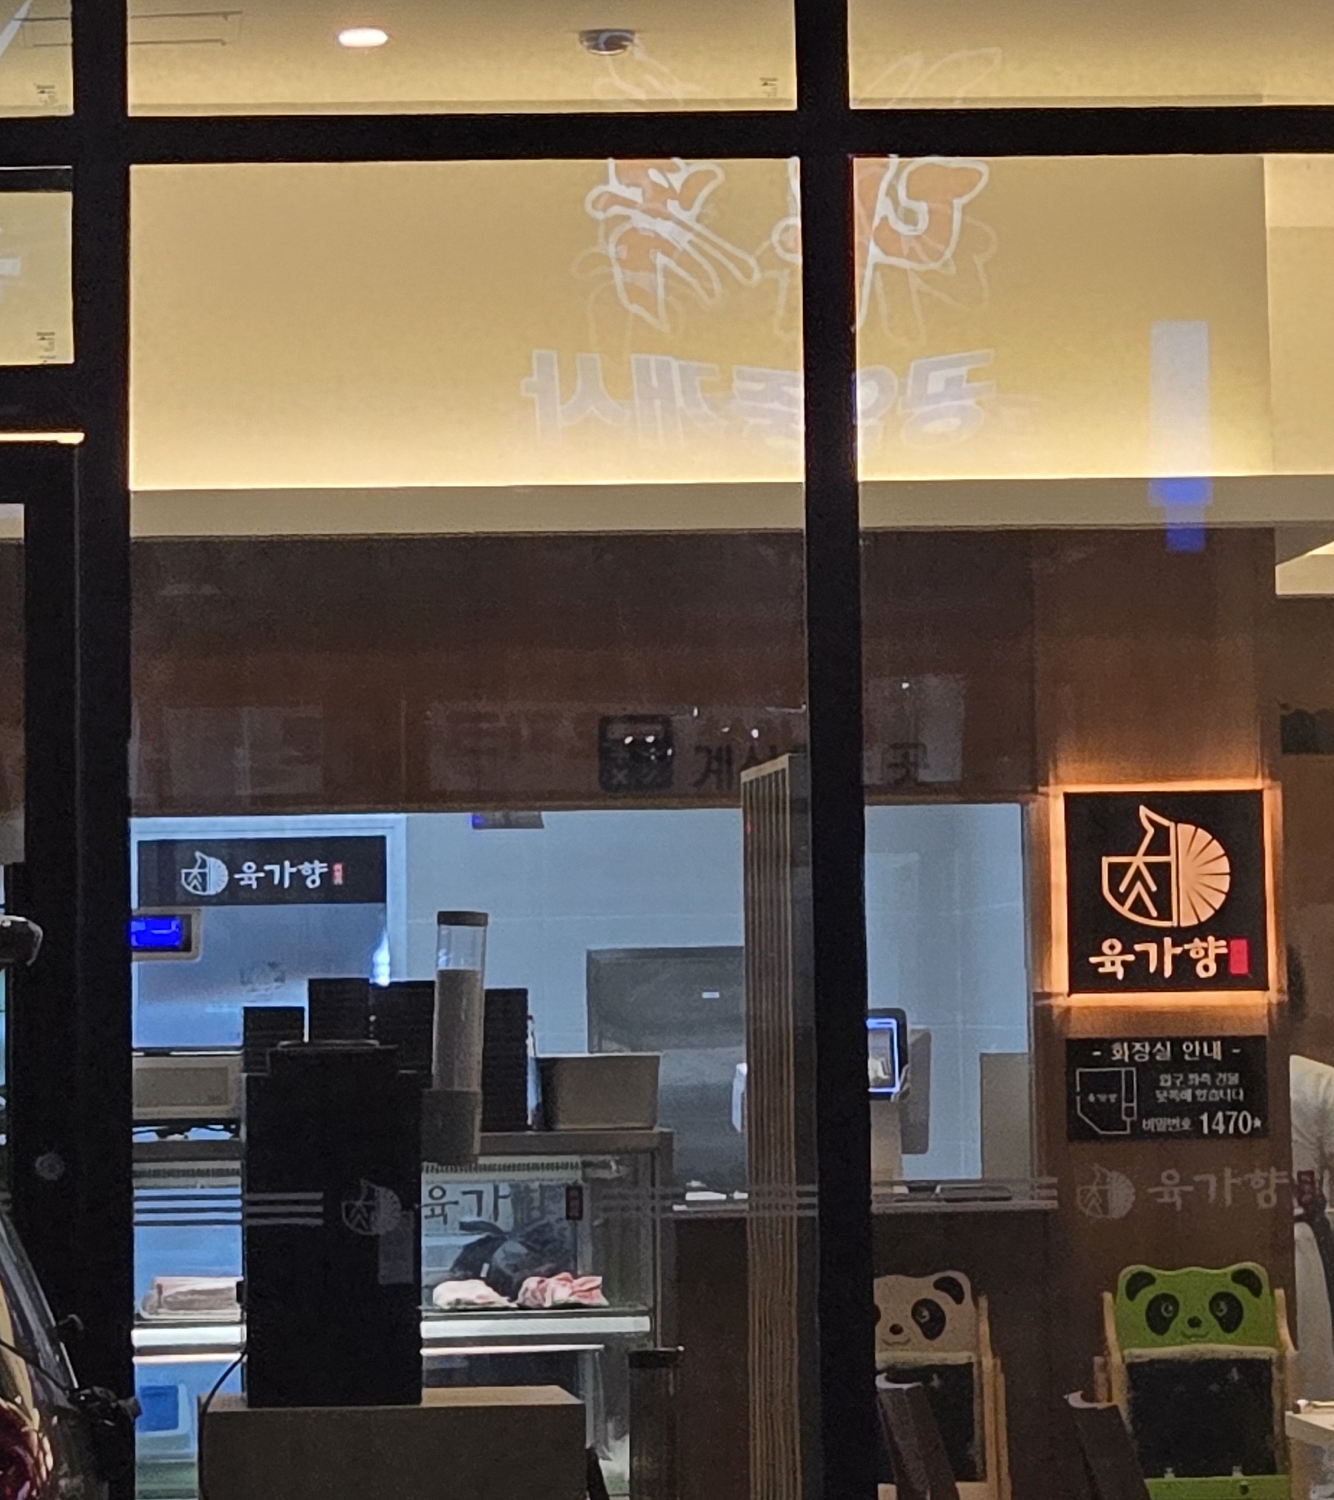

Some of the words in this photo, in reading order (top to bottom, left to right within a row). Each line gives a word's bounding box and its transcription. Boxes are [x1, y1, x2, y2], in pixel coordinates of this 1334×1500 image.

[233, 857, 330, 891] 육가향
[1087, 934, 1229, 981] 육가향
[1110, 1040, 1172, 1063] 화장실
[1181, 1039, 1223, 1062] 안내
[1146, 1165, 1291, 1214] 육가향
